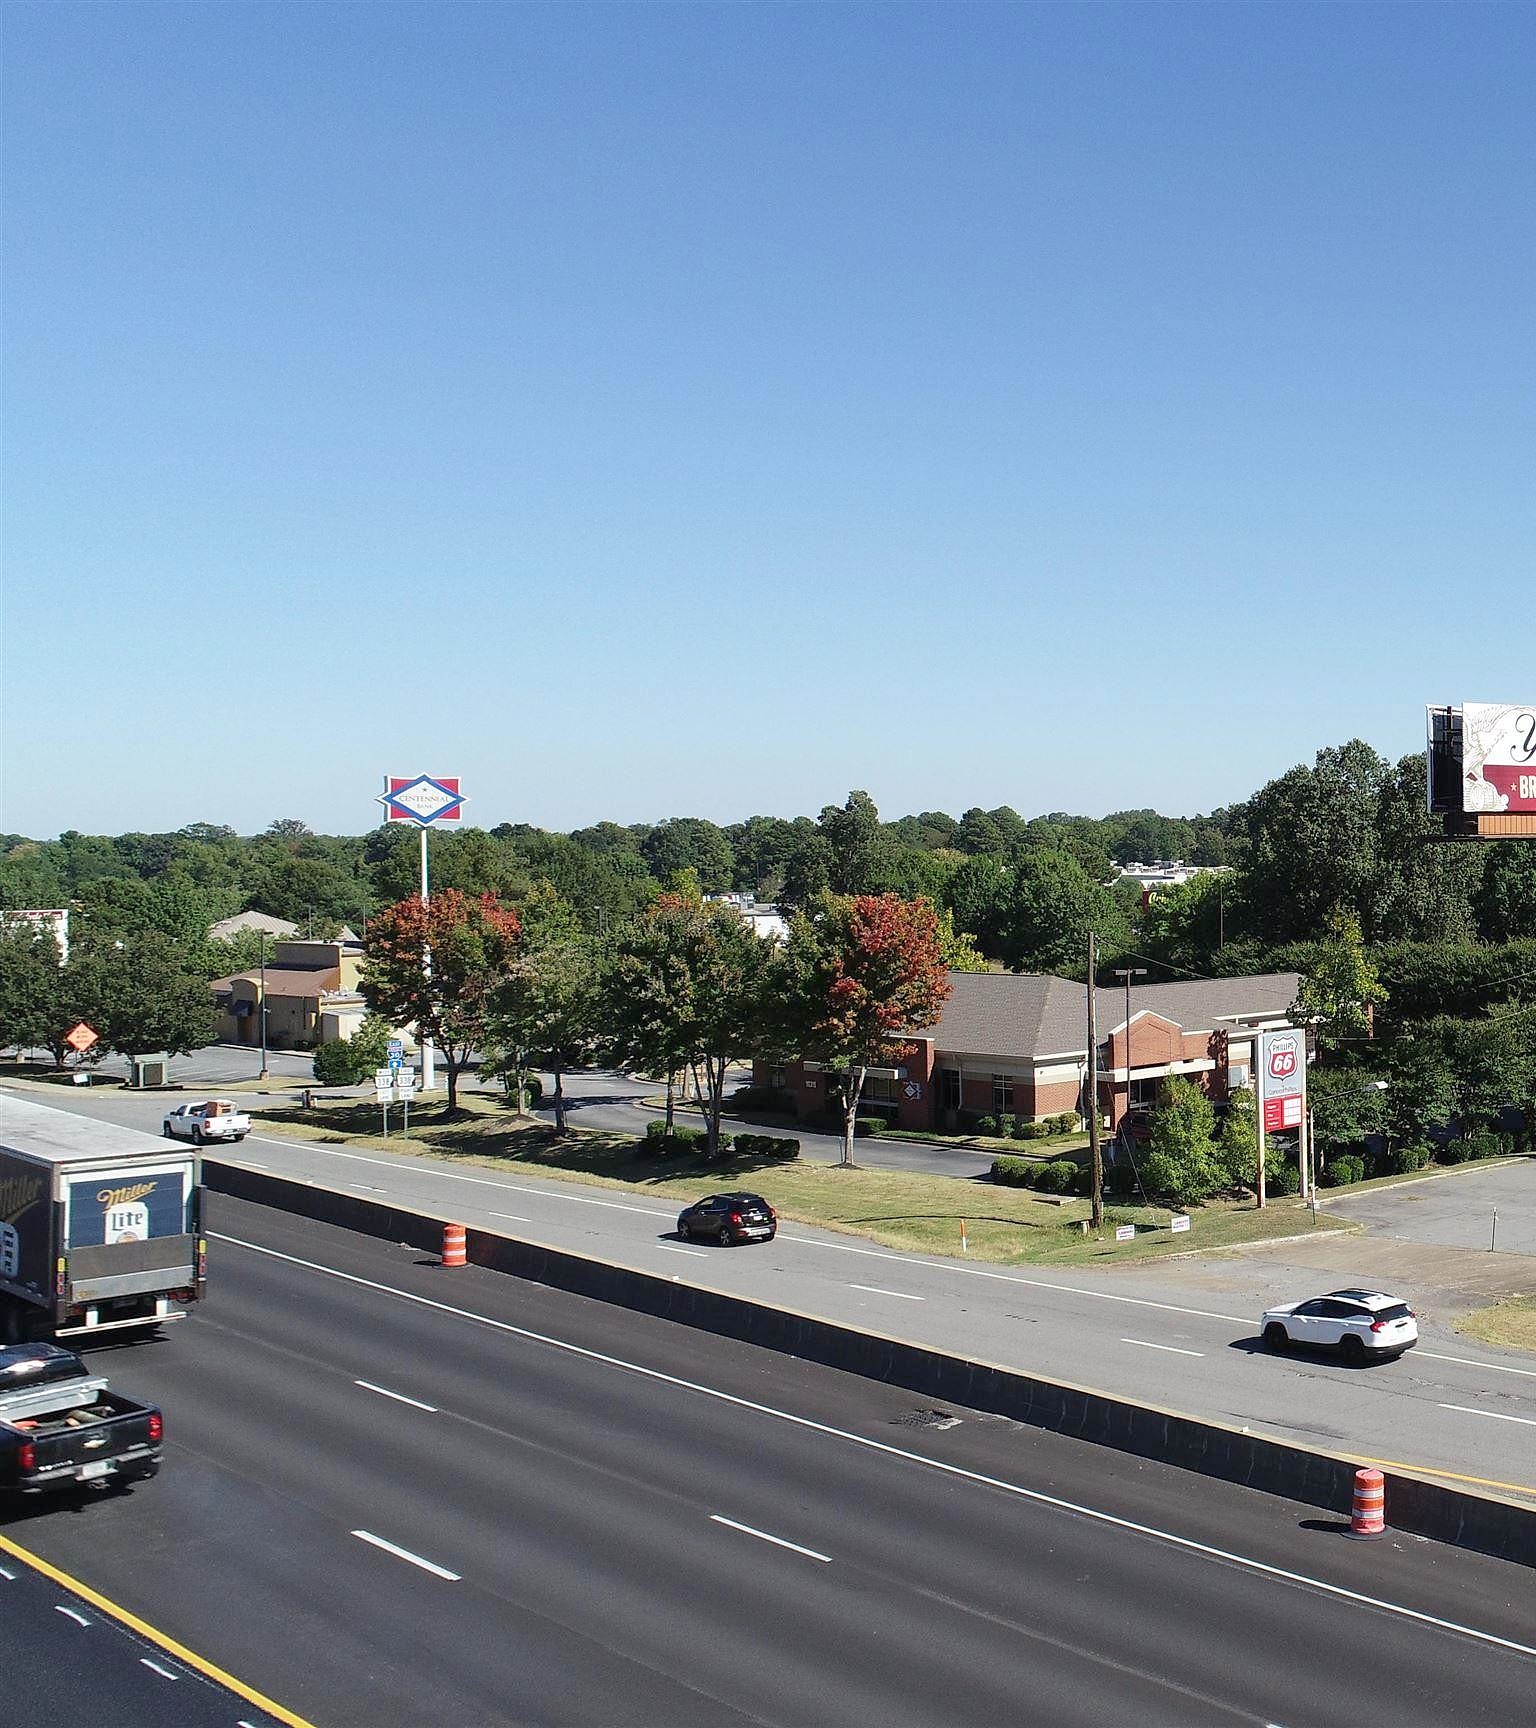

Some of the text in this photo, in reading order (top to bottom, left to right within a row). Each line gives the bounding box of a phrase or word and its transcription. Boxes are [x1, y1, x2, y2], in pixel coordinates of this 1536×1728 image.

[1273, 1042, 1294, 1053] PHILLIPS
[1273, 1054, 1294, 1071] 66
[97, 1182, 159, 1214] Miller
[112, 1212, 143, 1231] Lite
